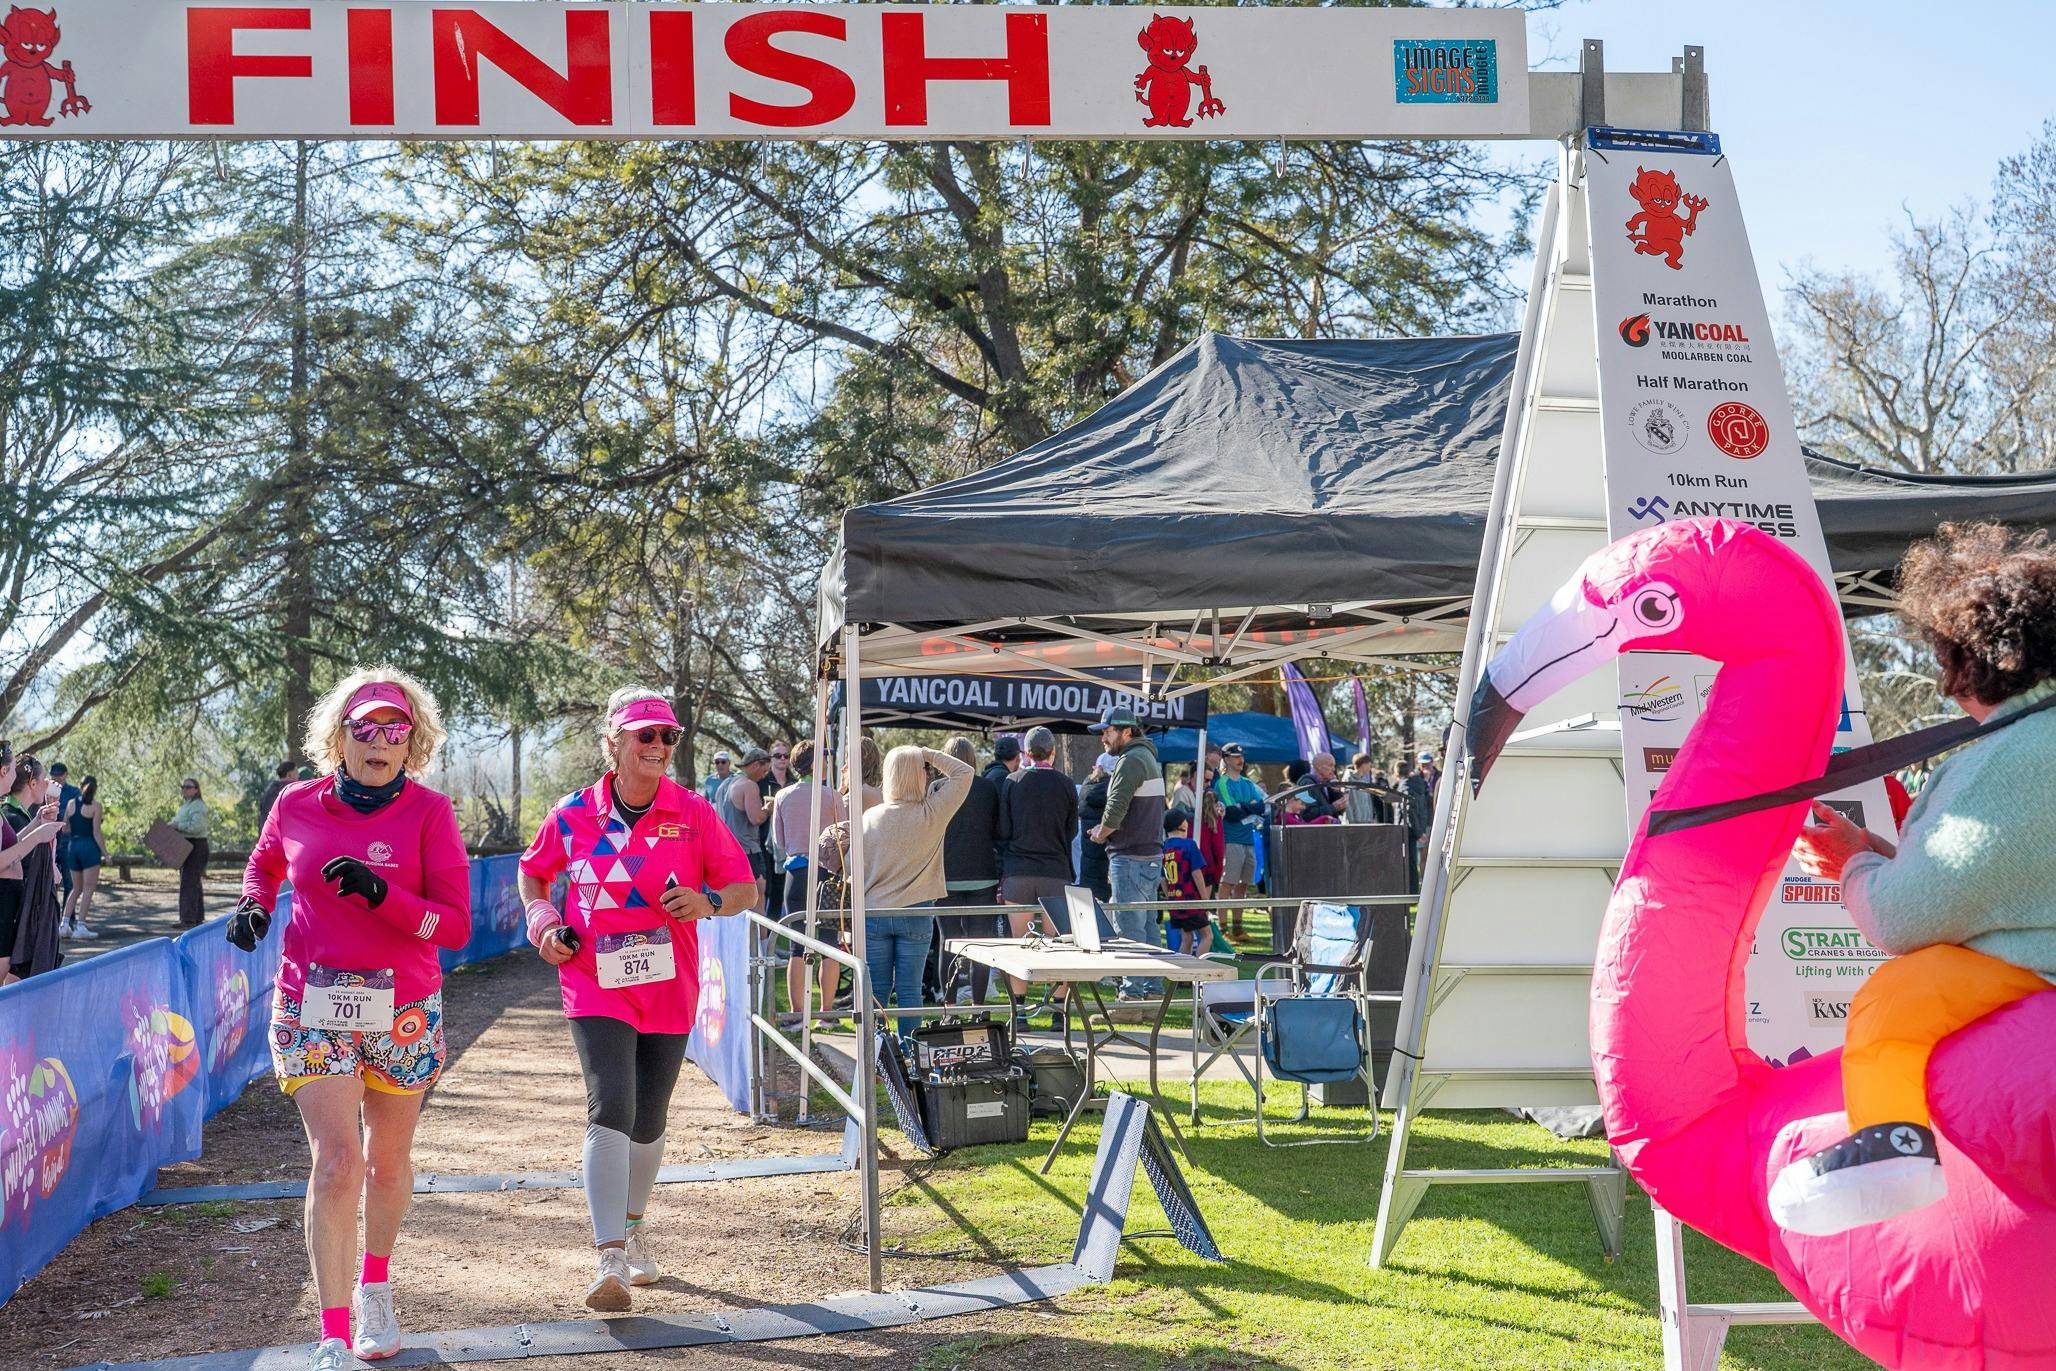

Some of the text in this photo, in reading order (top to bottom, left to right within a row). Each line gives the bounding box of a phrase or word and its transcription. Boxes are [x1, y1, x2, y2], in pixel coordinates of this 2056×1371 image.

[1405, 47, 1473, 69] IMAGE
[187, 7, 1051, 127] FINISH
[1475, 46, 1489, 95] MUDGEE
[1406, 68, 1475, 93] SIGNS
[1643, 293, 1717, 307] Marathon
[1654, 322, 1749, 342] YANCOAL
[1662, 351, 1752, 363] MOOLARBEN COAL
[1637, 375, 1748, 391] Half Marathon
[1628, 406, 1639, 426] LOWE
[1638, 398, 1664, 408] FAMILY
[1667, 402, 1685, 419] WINE
[1713, 406, 1763, 427] GOOREE
[1724, 442, 1760, 455] PARK
[1667, 473, 1748, 488] 10km Run
[1673, 500, 1793, 519] ANYTIME
[876, 677, 998, 708] YANCOAL
[1020, 683, 1185, 721] MOOLARBEN
[1784, 885, 1841, 902] SPORTS
[1788, 931, 1861, 956] STRAIT
[619, 952, 638, 961] 10KM
[640, 950, 655, 958] RUN
[1808, 949, 1893, 957] CRANES & RIGGIN
[624, 958, 649, 975] 874
[1796, 966, 1832, 978] Lifting
[1836, 966, 1864, 976] With
[328, 993, 350, 1001] 10KM
[333, 1002, 361, 1019] 701
